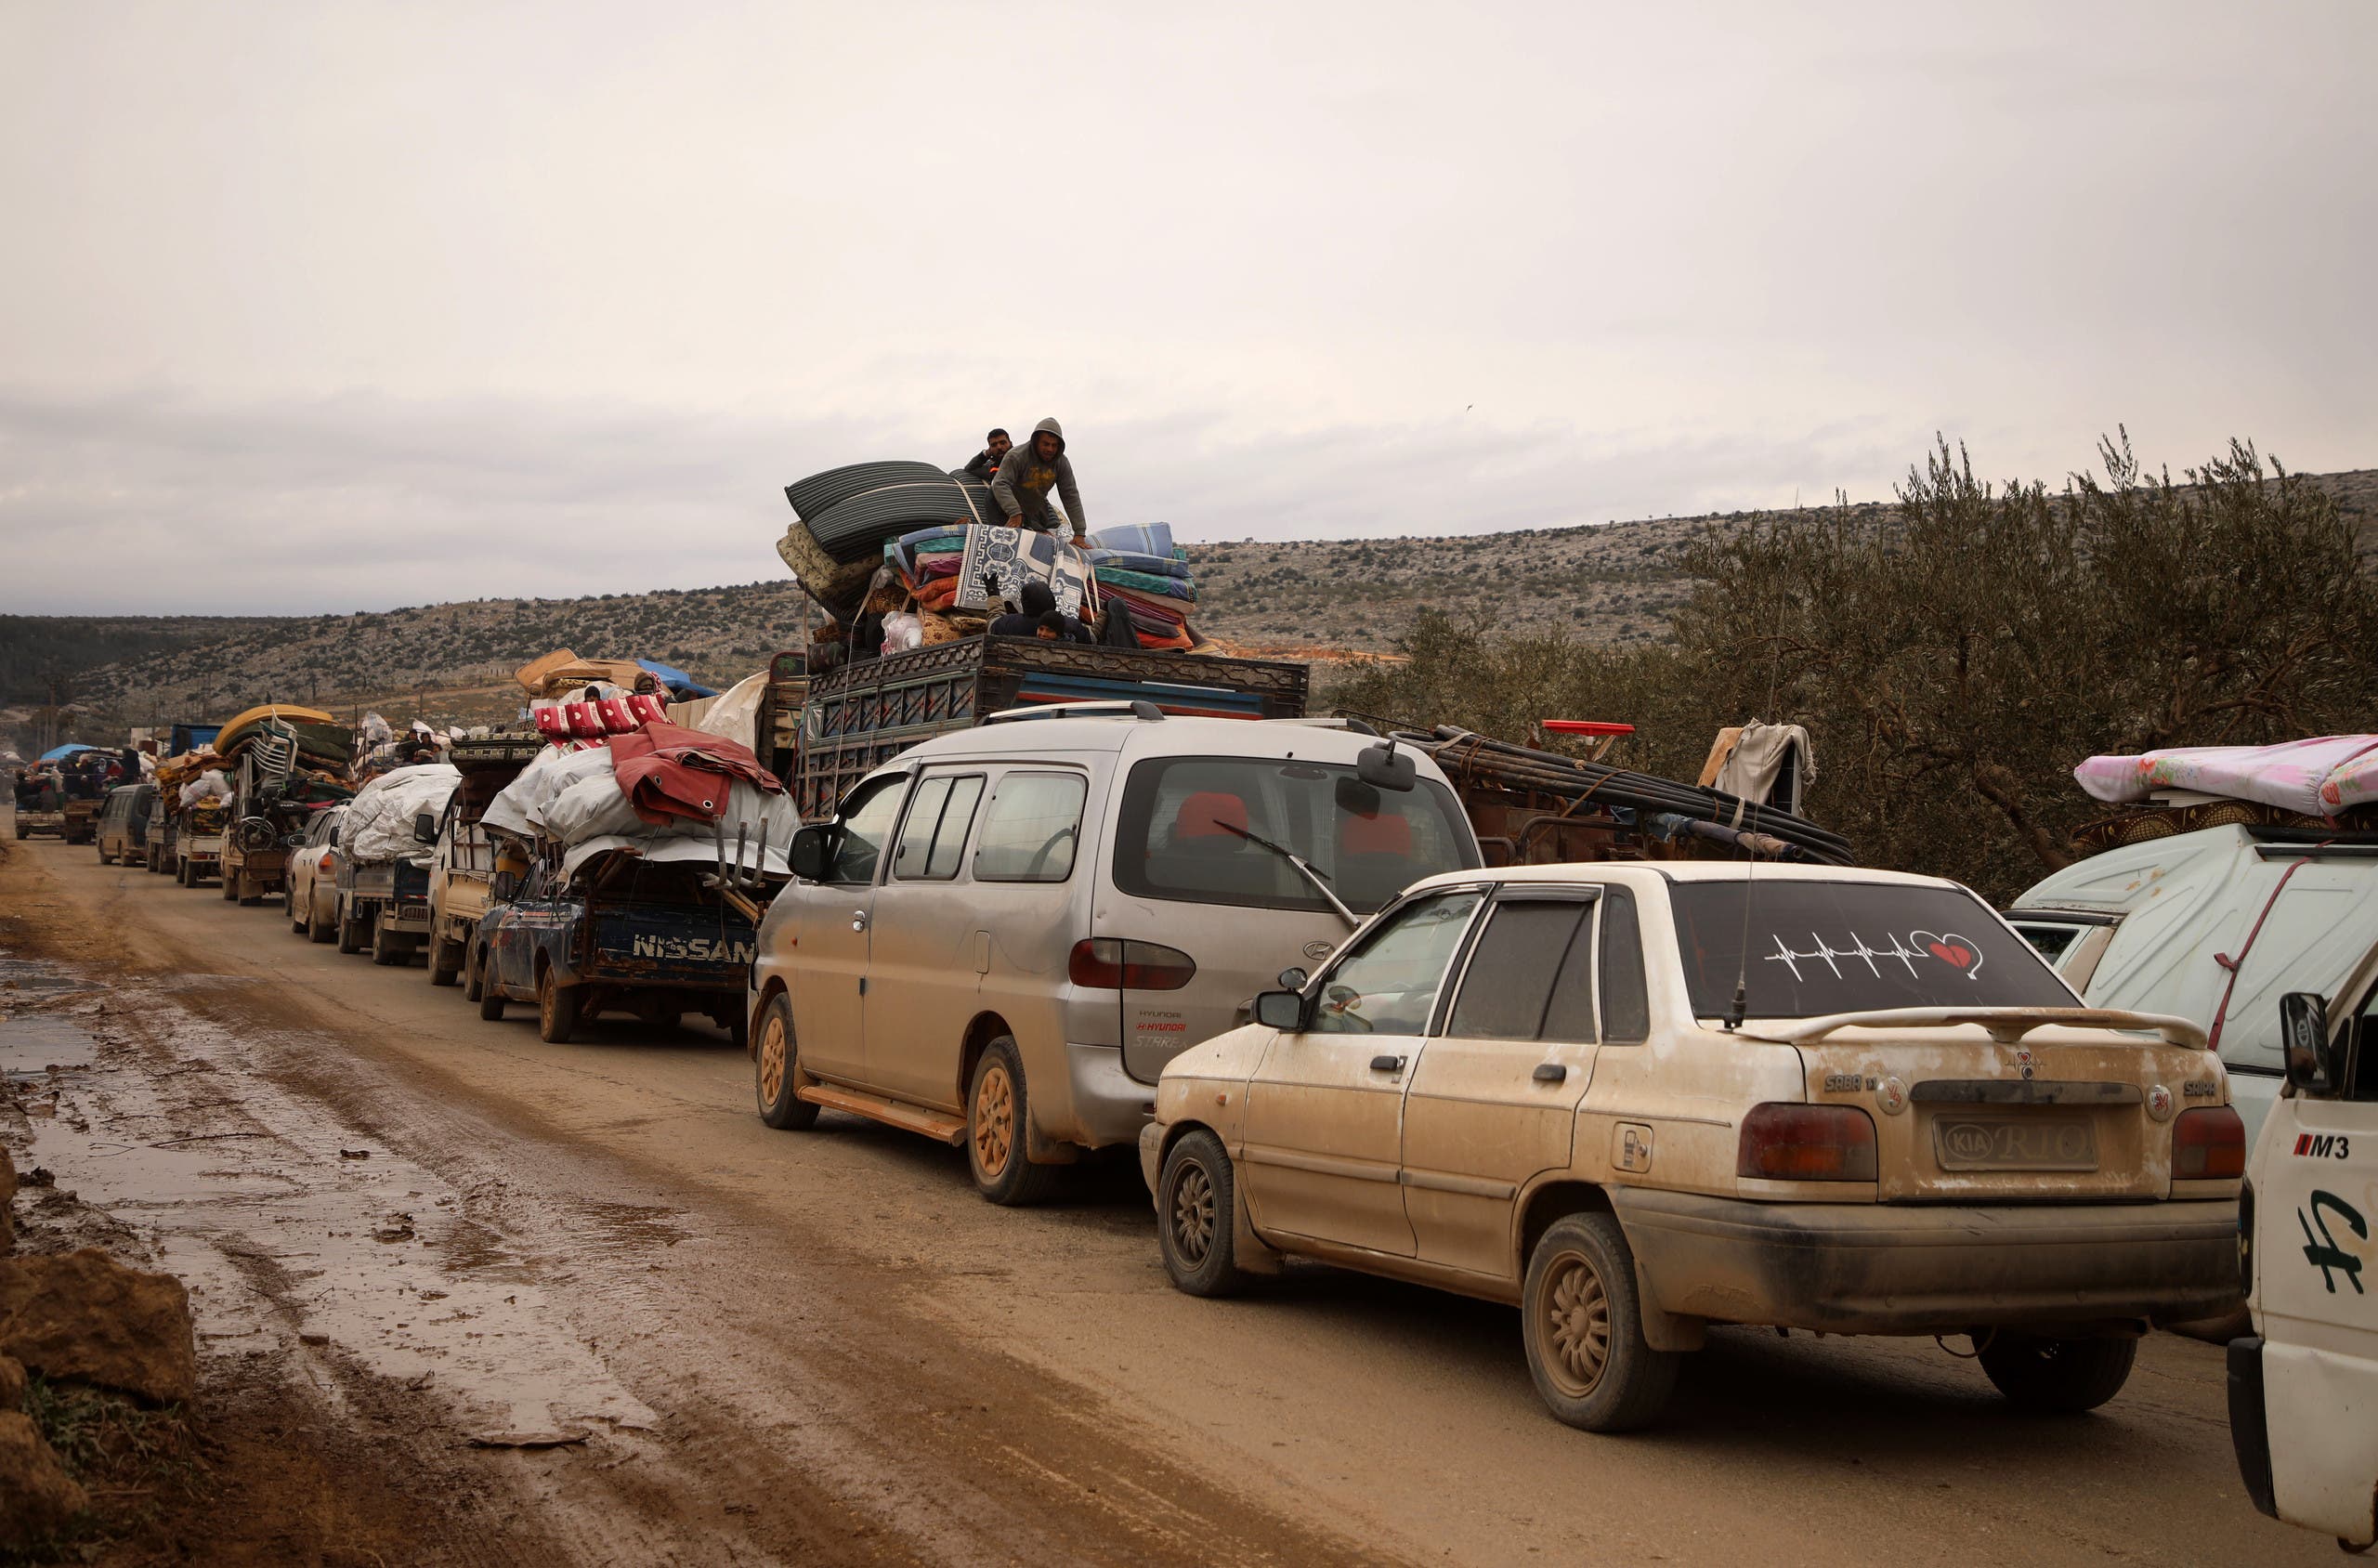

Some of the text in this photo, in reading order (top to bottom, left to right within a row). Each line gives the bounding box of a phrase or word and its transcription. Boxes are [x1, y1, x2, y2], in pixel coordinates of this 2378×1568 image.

[633, 934, 755, 964] NISSAN
[1139, 1010, 1182, 1019] HYUNDAI
[1147, 1023, 1187, 1032] HYUNDAI
[1953, 1124, 2089, 1160] KIA RIO
